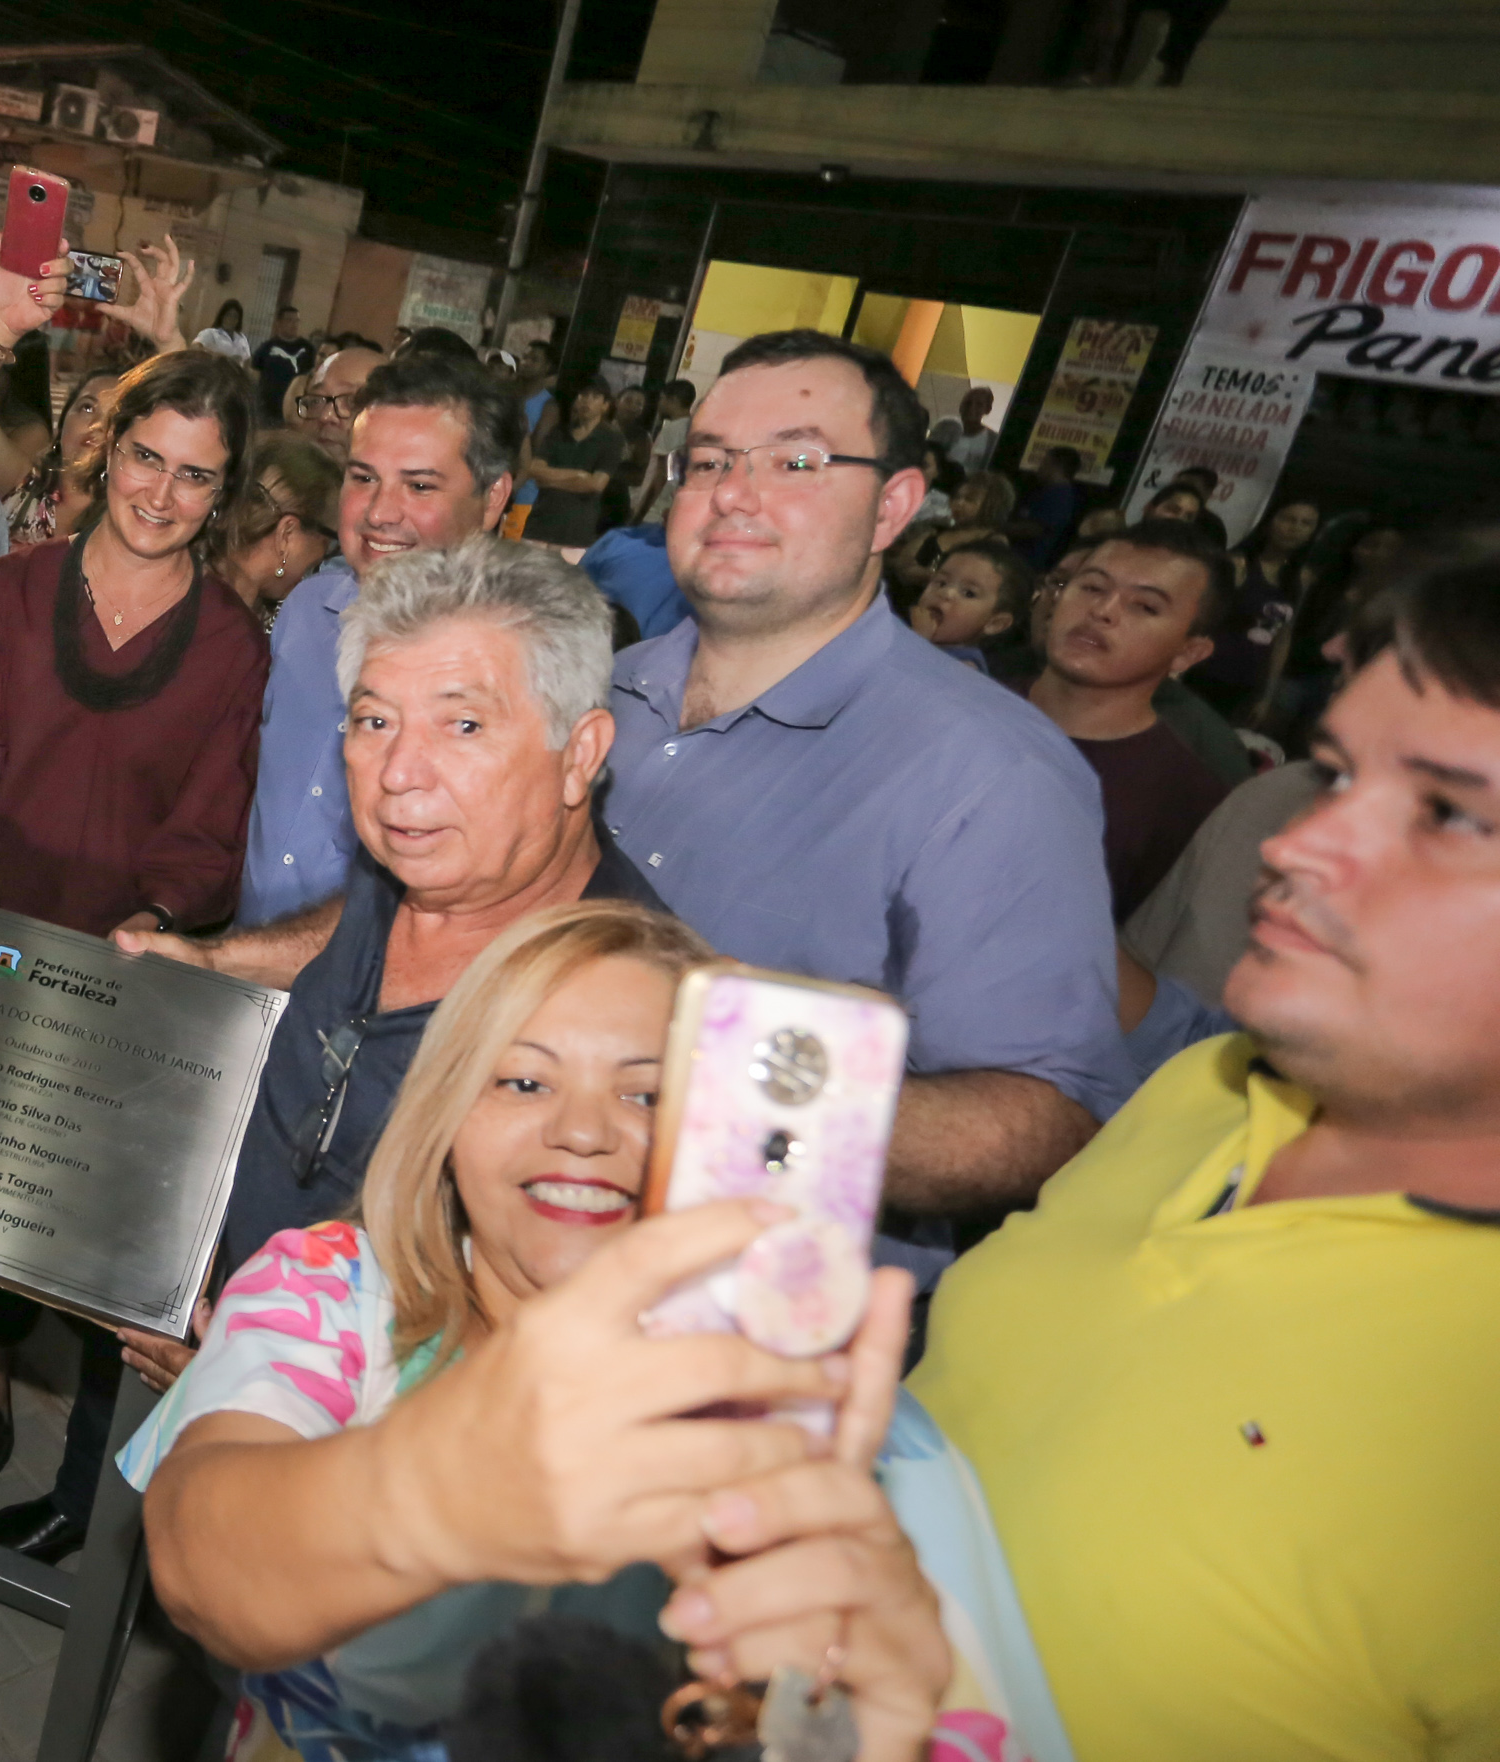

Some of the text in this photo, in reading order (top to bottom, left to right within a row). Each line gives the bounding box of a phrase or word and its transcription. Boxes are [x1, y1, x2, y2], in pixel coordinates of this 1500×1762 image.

[1227, 230, 1500, 317] FRIGO
[1202, 364, 1299, 399] TEMOS:
[28, 969, 118, 1007] Fortaleza
[34, 957, 123, 992] Prefeitura de
[4, 1036, 53, 1059] Outubro
[55, 1052, 70, 1064] de
[72, 1057, 102, 1073] 2019
[7, 1008, 31, 1023] DO
[107, 1036, 130, 1053] DO
[132, 1044, 167, 1065] BOM
[169, 1056, 222, 1082] JARDIM
[6, 1064, 71, 1094] Rodrigues
[73, 1085, 123, 1110] Bezerra
[20, 1104, 52, 1123] Silva
[54, 1114, 82, 1133] Dias
[29, 1143, 91, 1173] Nogueira
[7, 1172, 54, 1198] Torgan
